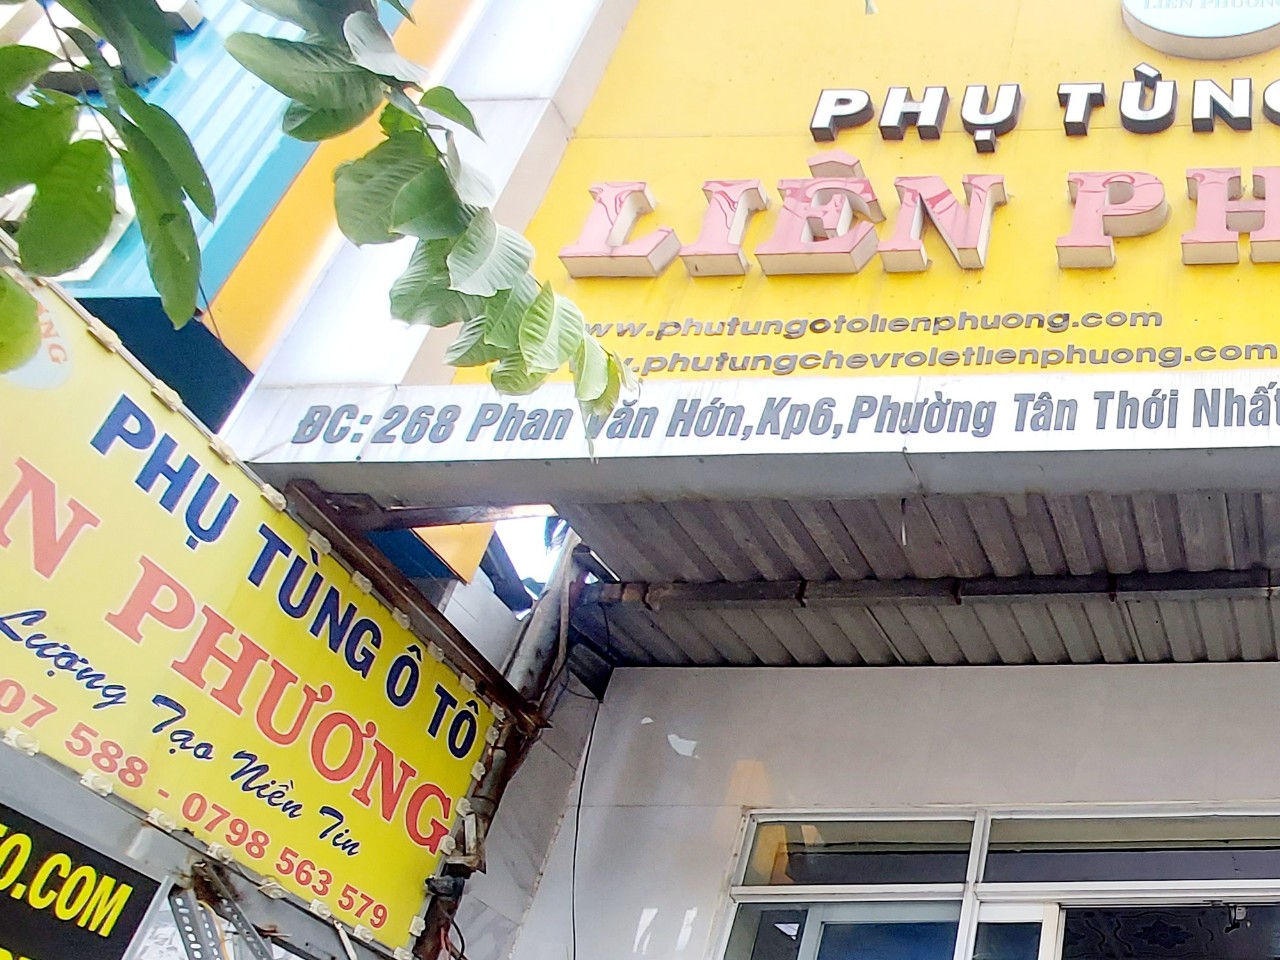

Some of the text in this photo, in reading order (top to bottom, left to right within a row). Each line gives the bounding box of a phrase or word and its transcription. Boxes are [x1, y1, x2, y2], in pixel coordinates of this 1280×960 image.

[810, 83, 1022, 153] PHỤ
[559, 149, 1010, 278] LIÊN
[568, 340, 1278, 376] .phutungchevroletlienphuong.com
[585, 308, 1162, 341] ww.phutungotolienphuong.com
[466, 402, 574, 442] Phan
[1013, 391, 1079, 432] Tân
[1094, 389, 1179, 430] Thới
[90, 393, 479, 759] PHỤ TÙNG Ô TÔ
[0, 610, 127, 709] Lượng
[151, 694, 214, 760] Tạo
[319, 805, 361, 856] Tin
[105, 555, 452, 854] PHƯƠNG
[0, 823, 134, 937] O.COM
[64, 722, 149, 788] 588
[181, 792, 270, 859] 0798
[275, 847, 333, 896] 563
[337, 884, 388, 929] 579
